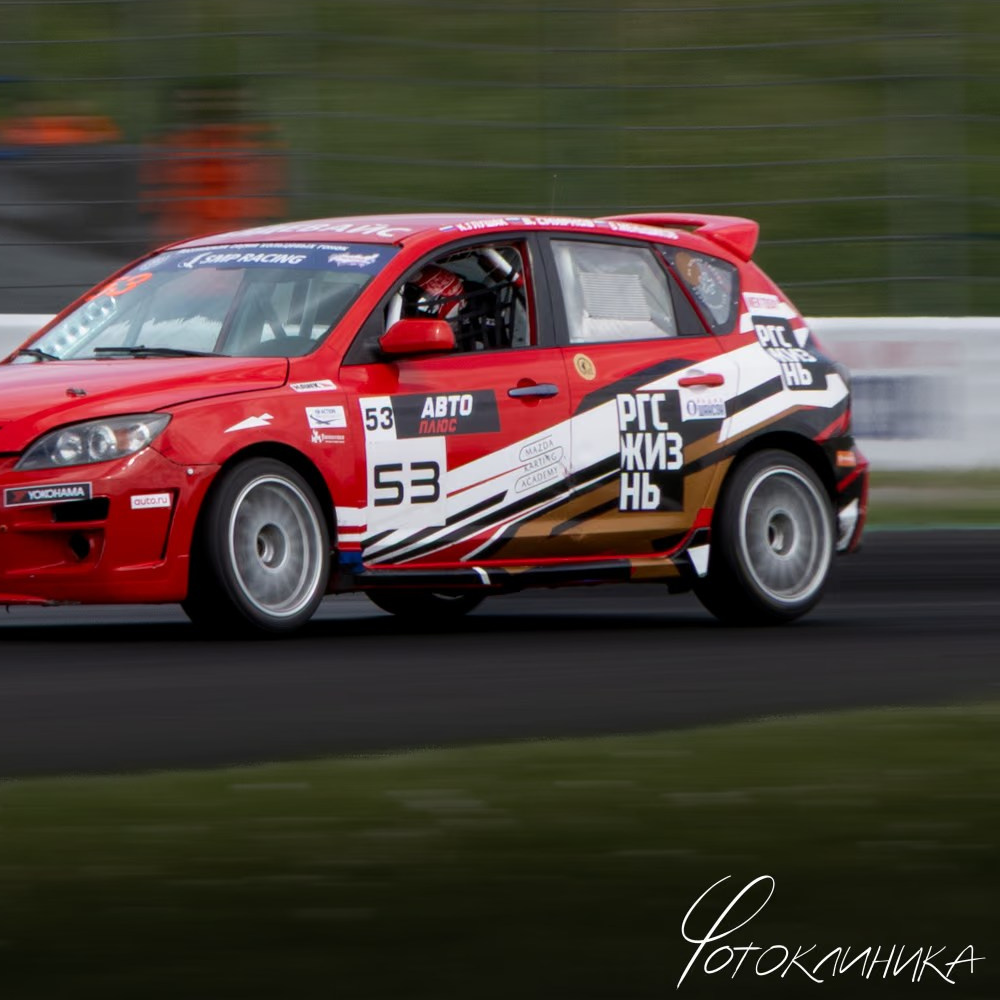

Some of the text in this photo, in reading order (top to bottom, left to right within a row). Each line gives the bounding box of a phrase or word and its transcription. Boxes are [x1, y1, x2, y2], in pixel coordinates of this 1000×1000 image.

[200, 253, 307, 265] SMP RACING
[754, 324, 792, 348] РГС
[421, 394, 473, 419] АВТО
[616, 393, 669, 431] РГС
[365, 406, 393, 431] 53
[419, 418, 457, 434] ПЛЮС
[525, 440, 554, 456] MAZDA
[620, 432, 684, 471] ЖИЗ
[523, 452, 558, 472] KARTING
[374, 461, 440, 507] 53
[521, 467, 558, 488] ACADEMY
[28, 487, 85, 500] YOKOHAMA
[134, 493, 168, 506] auto.ru
[619, 472, 661, 511] НЬ
